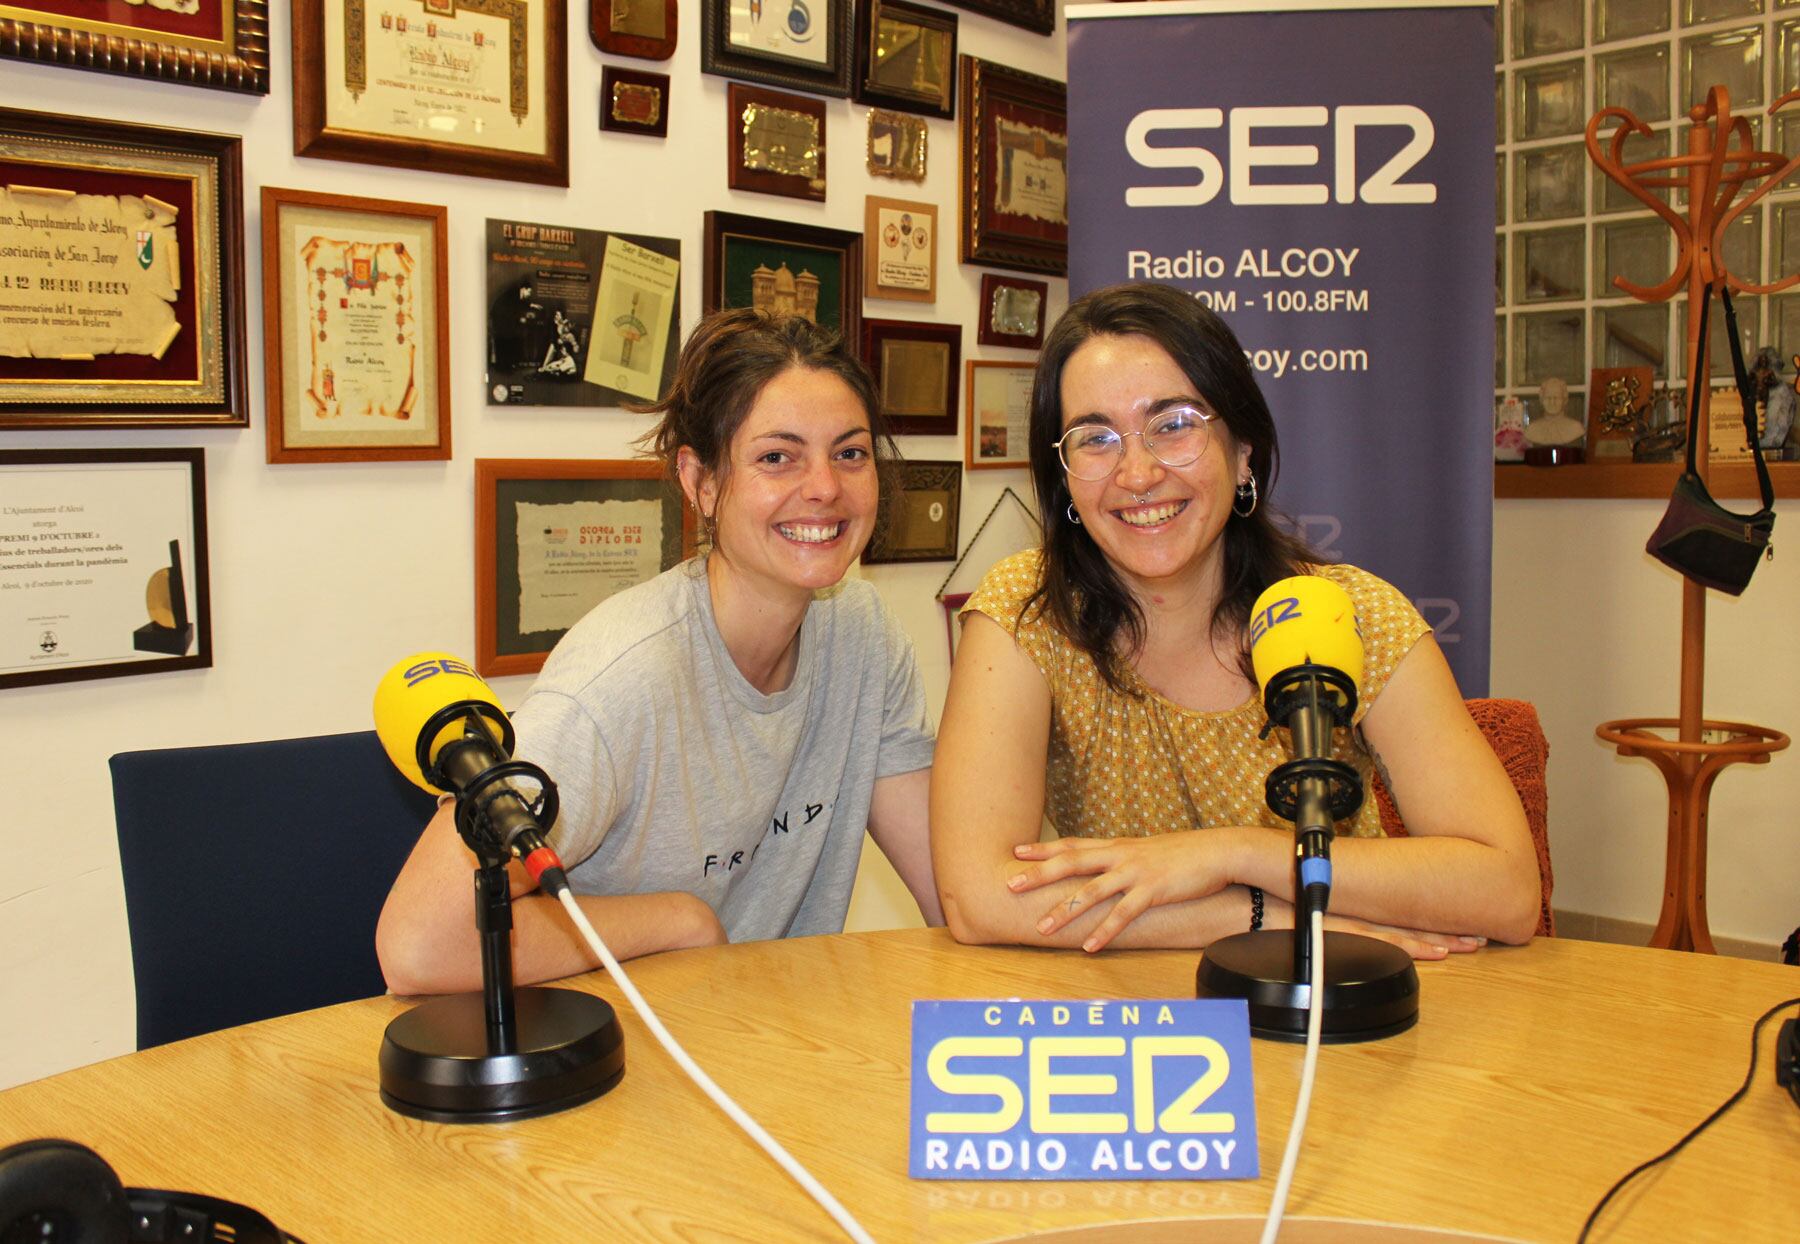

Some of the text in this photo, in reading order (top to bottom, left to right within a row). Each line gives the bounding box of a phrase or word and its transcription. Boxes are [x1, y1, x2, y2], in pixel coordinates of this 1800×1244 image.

[1125, 105, 1437, 207] SER
[89, 220, 98, 232] de
[100, 218, 128, 239] Alcoy
[503, 223, 513, 238] EL
[0, 245, 50, 260] sociación
[54, 246, 66, 261] de
[68, 245, 89, 262] San
[1127, 249, 1360, 279] Radio ALCOY
[40, 277, 83, 293] RADIO
[88, 281, 131, 296] ALCOY
[1263, 290, 1368, 312] 100.8FM
[3, 506, 56, 516] L'Ajuntament
[40, 532, 93, 542] D'OCTUBRE
[579, 536, 642, 544] DIPLOMA
[15, 548, 25, 556] de
[105, 544, 123, 552] dels
[44, 559, 75, 568] durant
[1251, 597, 1302, 647] ER
[984, 1005, 1174, 1026] CADENA
[926, 1036, 1236, 1133] SER
[926, 1138, 1236, 1171] RADIO ALCOY
